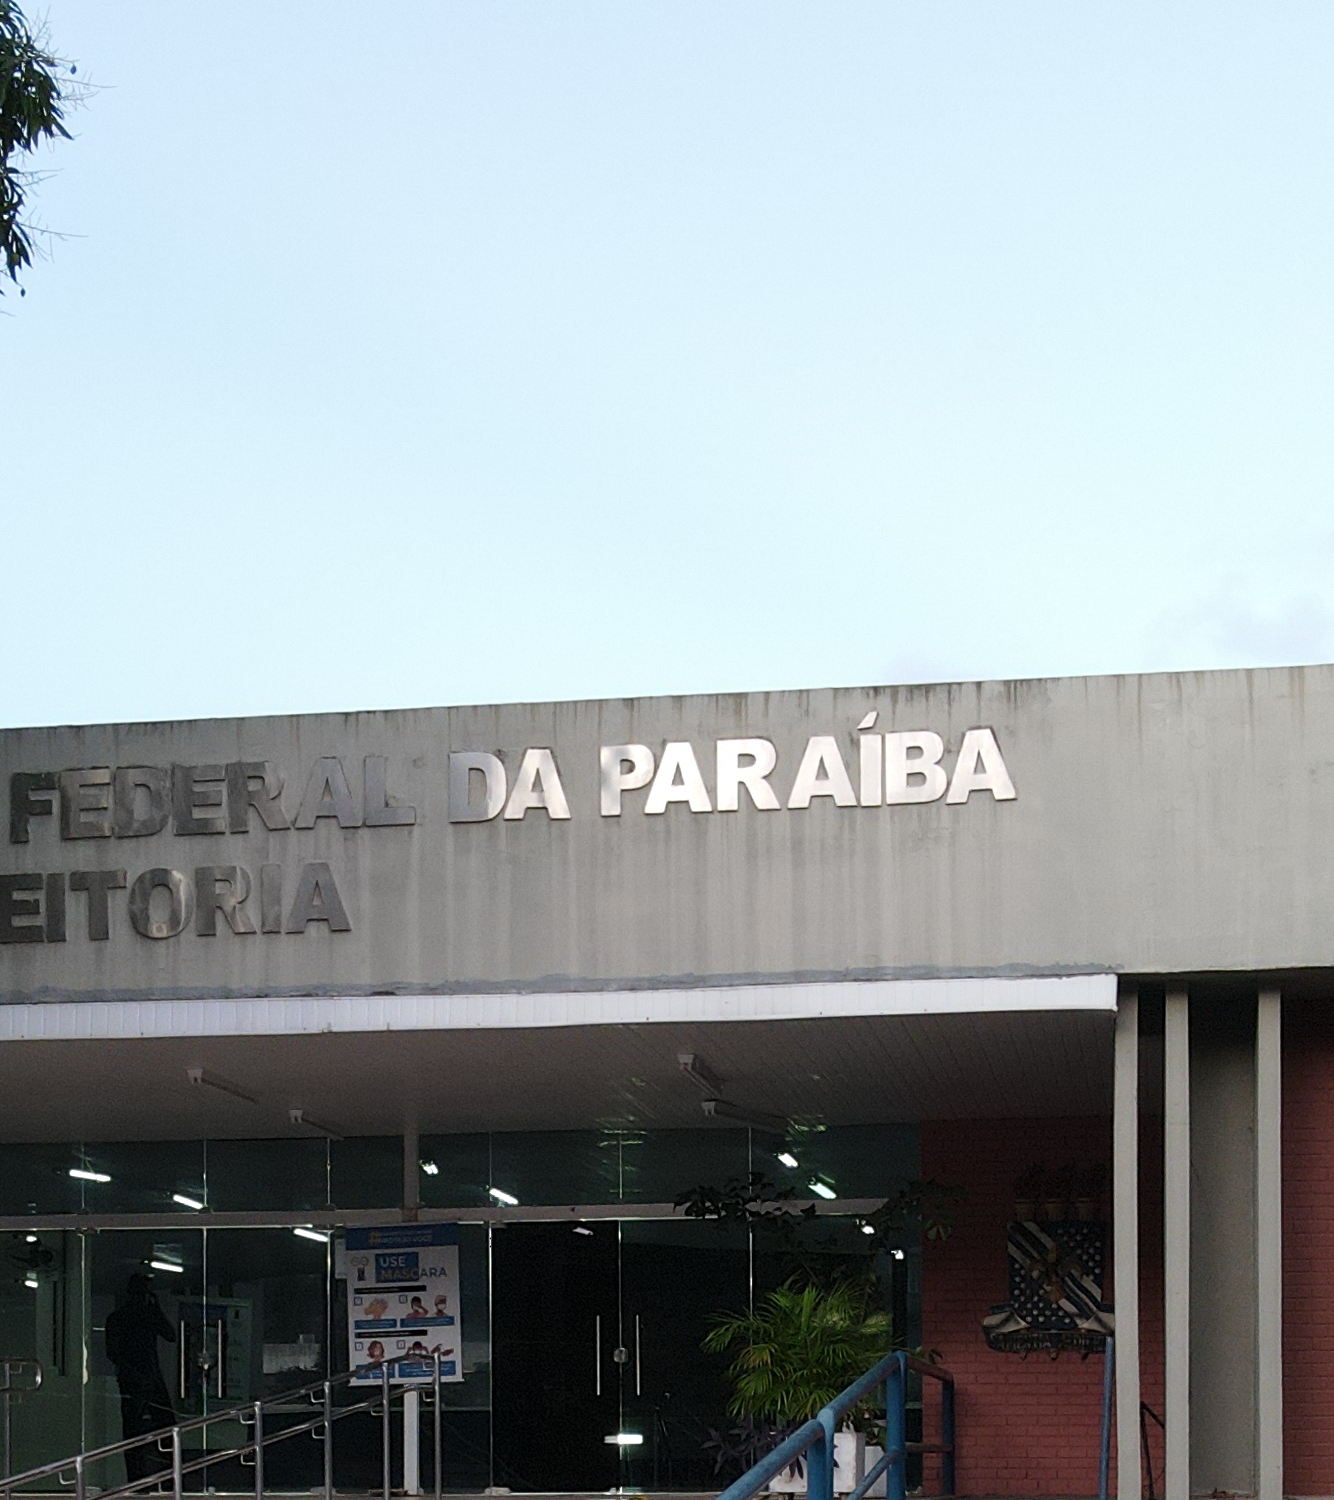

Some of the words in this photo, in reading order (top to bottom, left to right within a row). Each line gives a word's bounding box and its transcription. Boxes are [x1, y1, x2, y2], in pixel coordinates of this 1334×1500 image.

[10, 755, 416, 843] FEDERAL
[448, 747, 571, 822] DA
[600, 711, 1018, 816] PARAÍBA
[380, 1255, 406, 1268] USE
